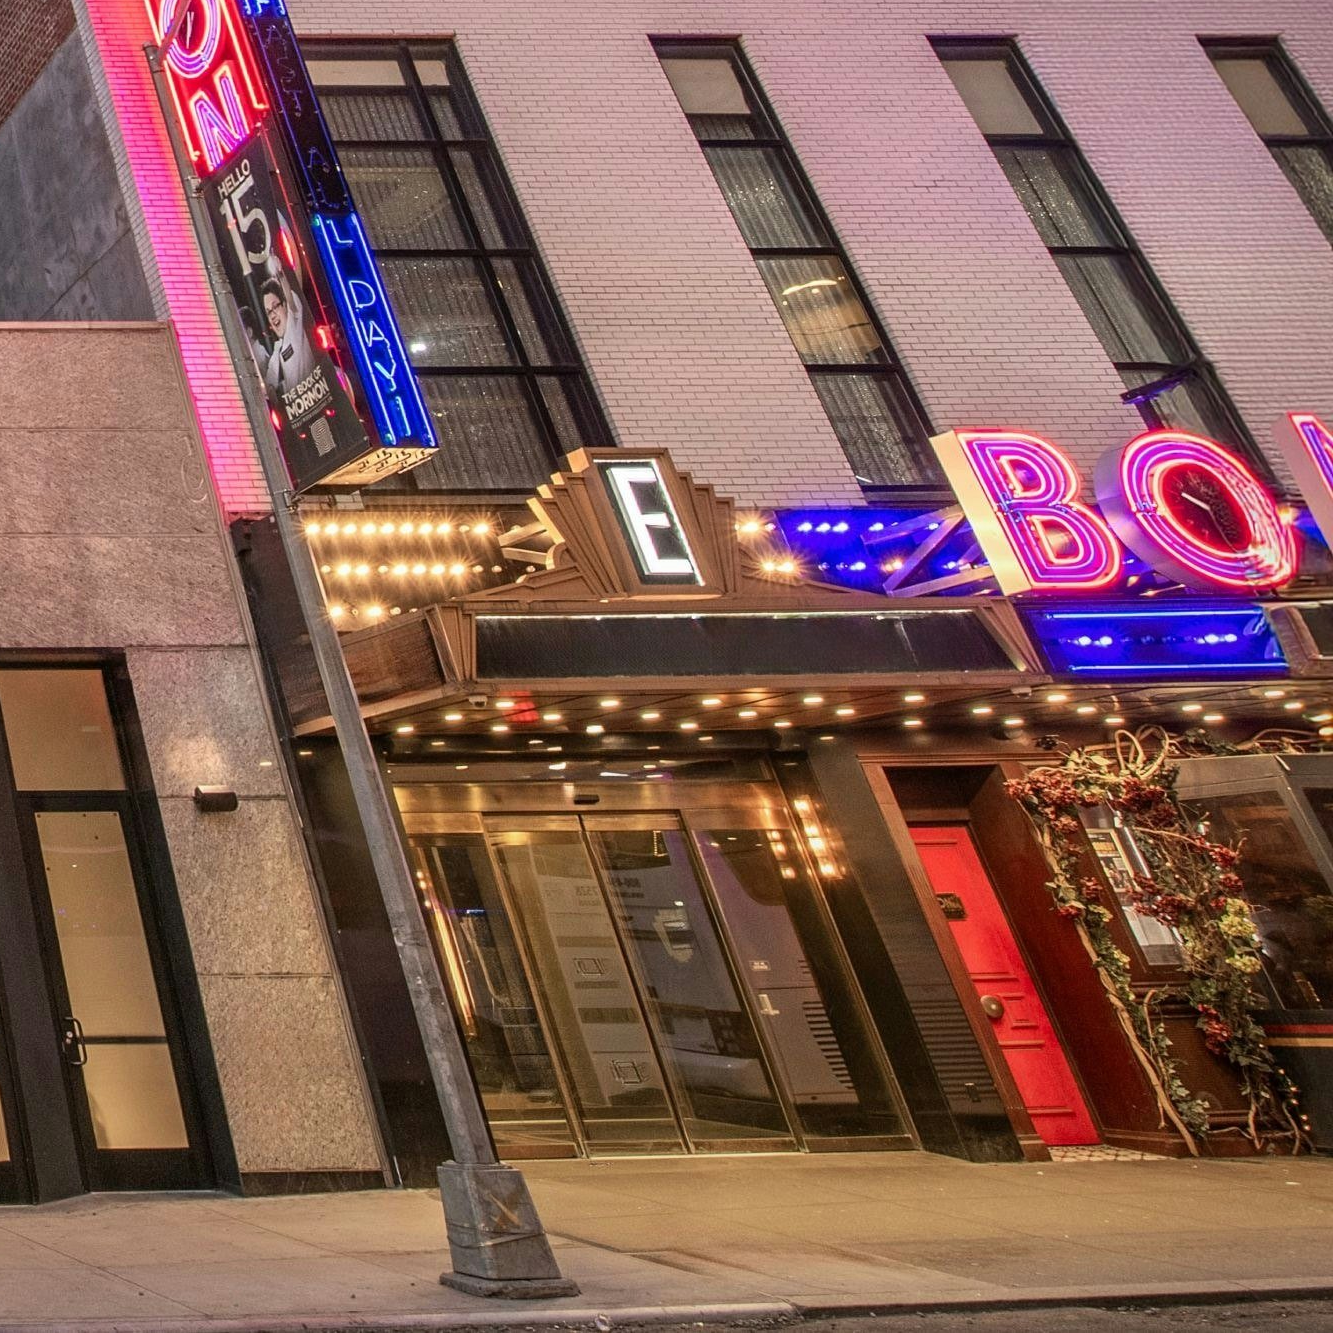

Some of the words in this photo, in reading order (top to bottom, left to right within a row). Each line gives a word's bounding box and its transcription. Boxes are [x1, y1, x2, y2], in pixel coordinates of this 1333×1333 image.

[217, 159, 251, 201] HELLO
[219, 174, 271, 276] 15
[282, 388, 298, 405] THE
[296, 374, 317, 394] BOOK
[314, 366, 323, 380] OF
[285, 377, 330, 421] MORMON
[606, 467, 694, 576] E
